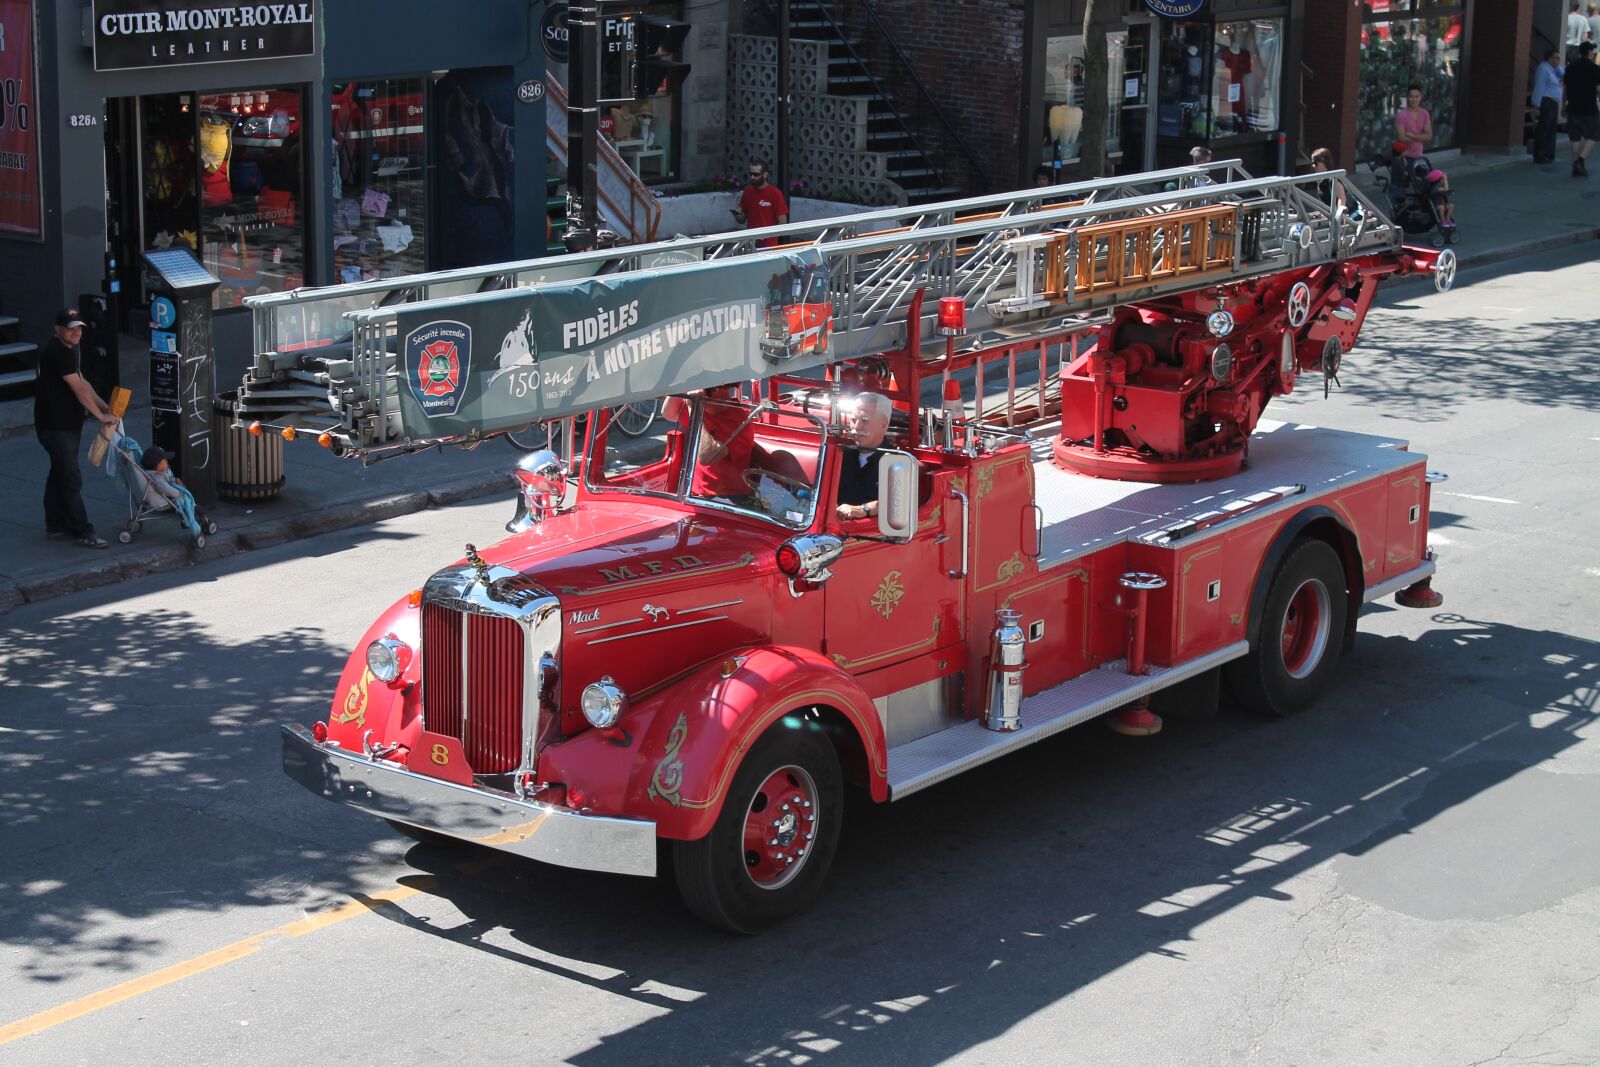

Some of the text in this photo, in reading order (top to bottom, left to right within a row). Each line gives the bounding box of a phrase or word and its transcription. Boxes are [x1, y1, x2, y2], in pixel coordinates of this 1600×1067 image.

[101, 3, 313, 36] CUIR MONT-ROYAL
[152, 38, 265, 57] LEATHER
[609, 42, 621, 52] ET
[520, 83, 541, 98] 826
[71, 115, 97, 127] 826A
[563, 299, 639, 349] FIDÈLES
[412, 327, 466, 346] Sécurité incendie
[586, 303, 757, 382] À NOTRE VOCATION
[508, 366, 575, 398] 150 ans
[422, 398, 449, 408] Montréal
[568, 608, 601, 625] Mack
[431, 743, 449, 765] 8
